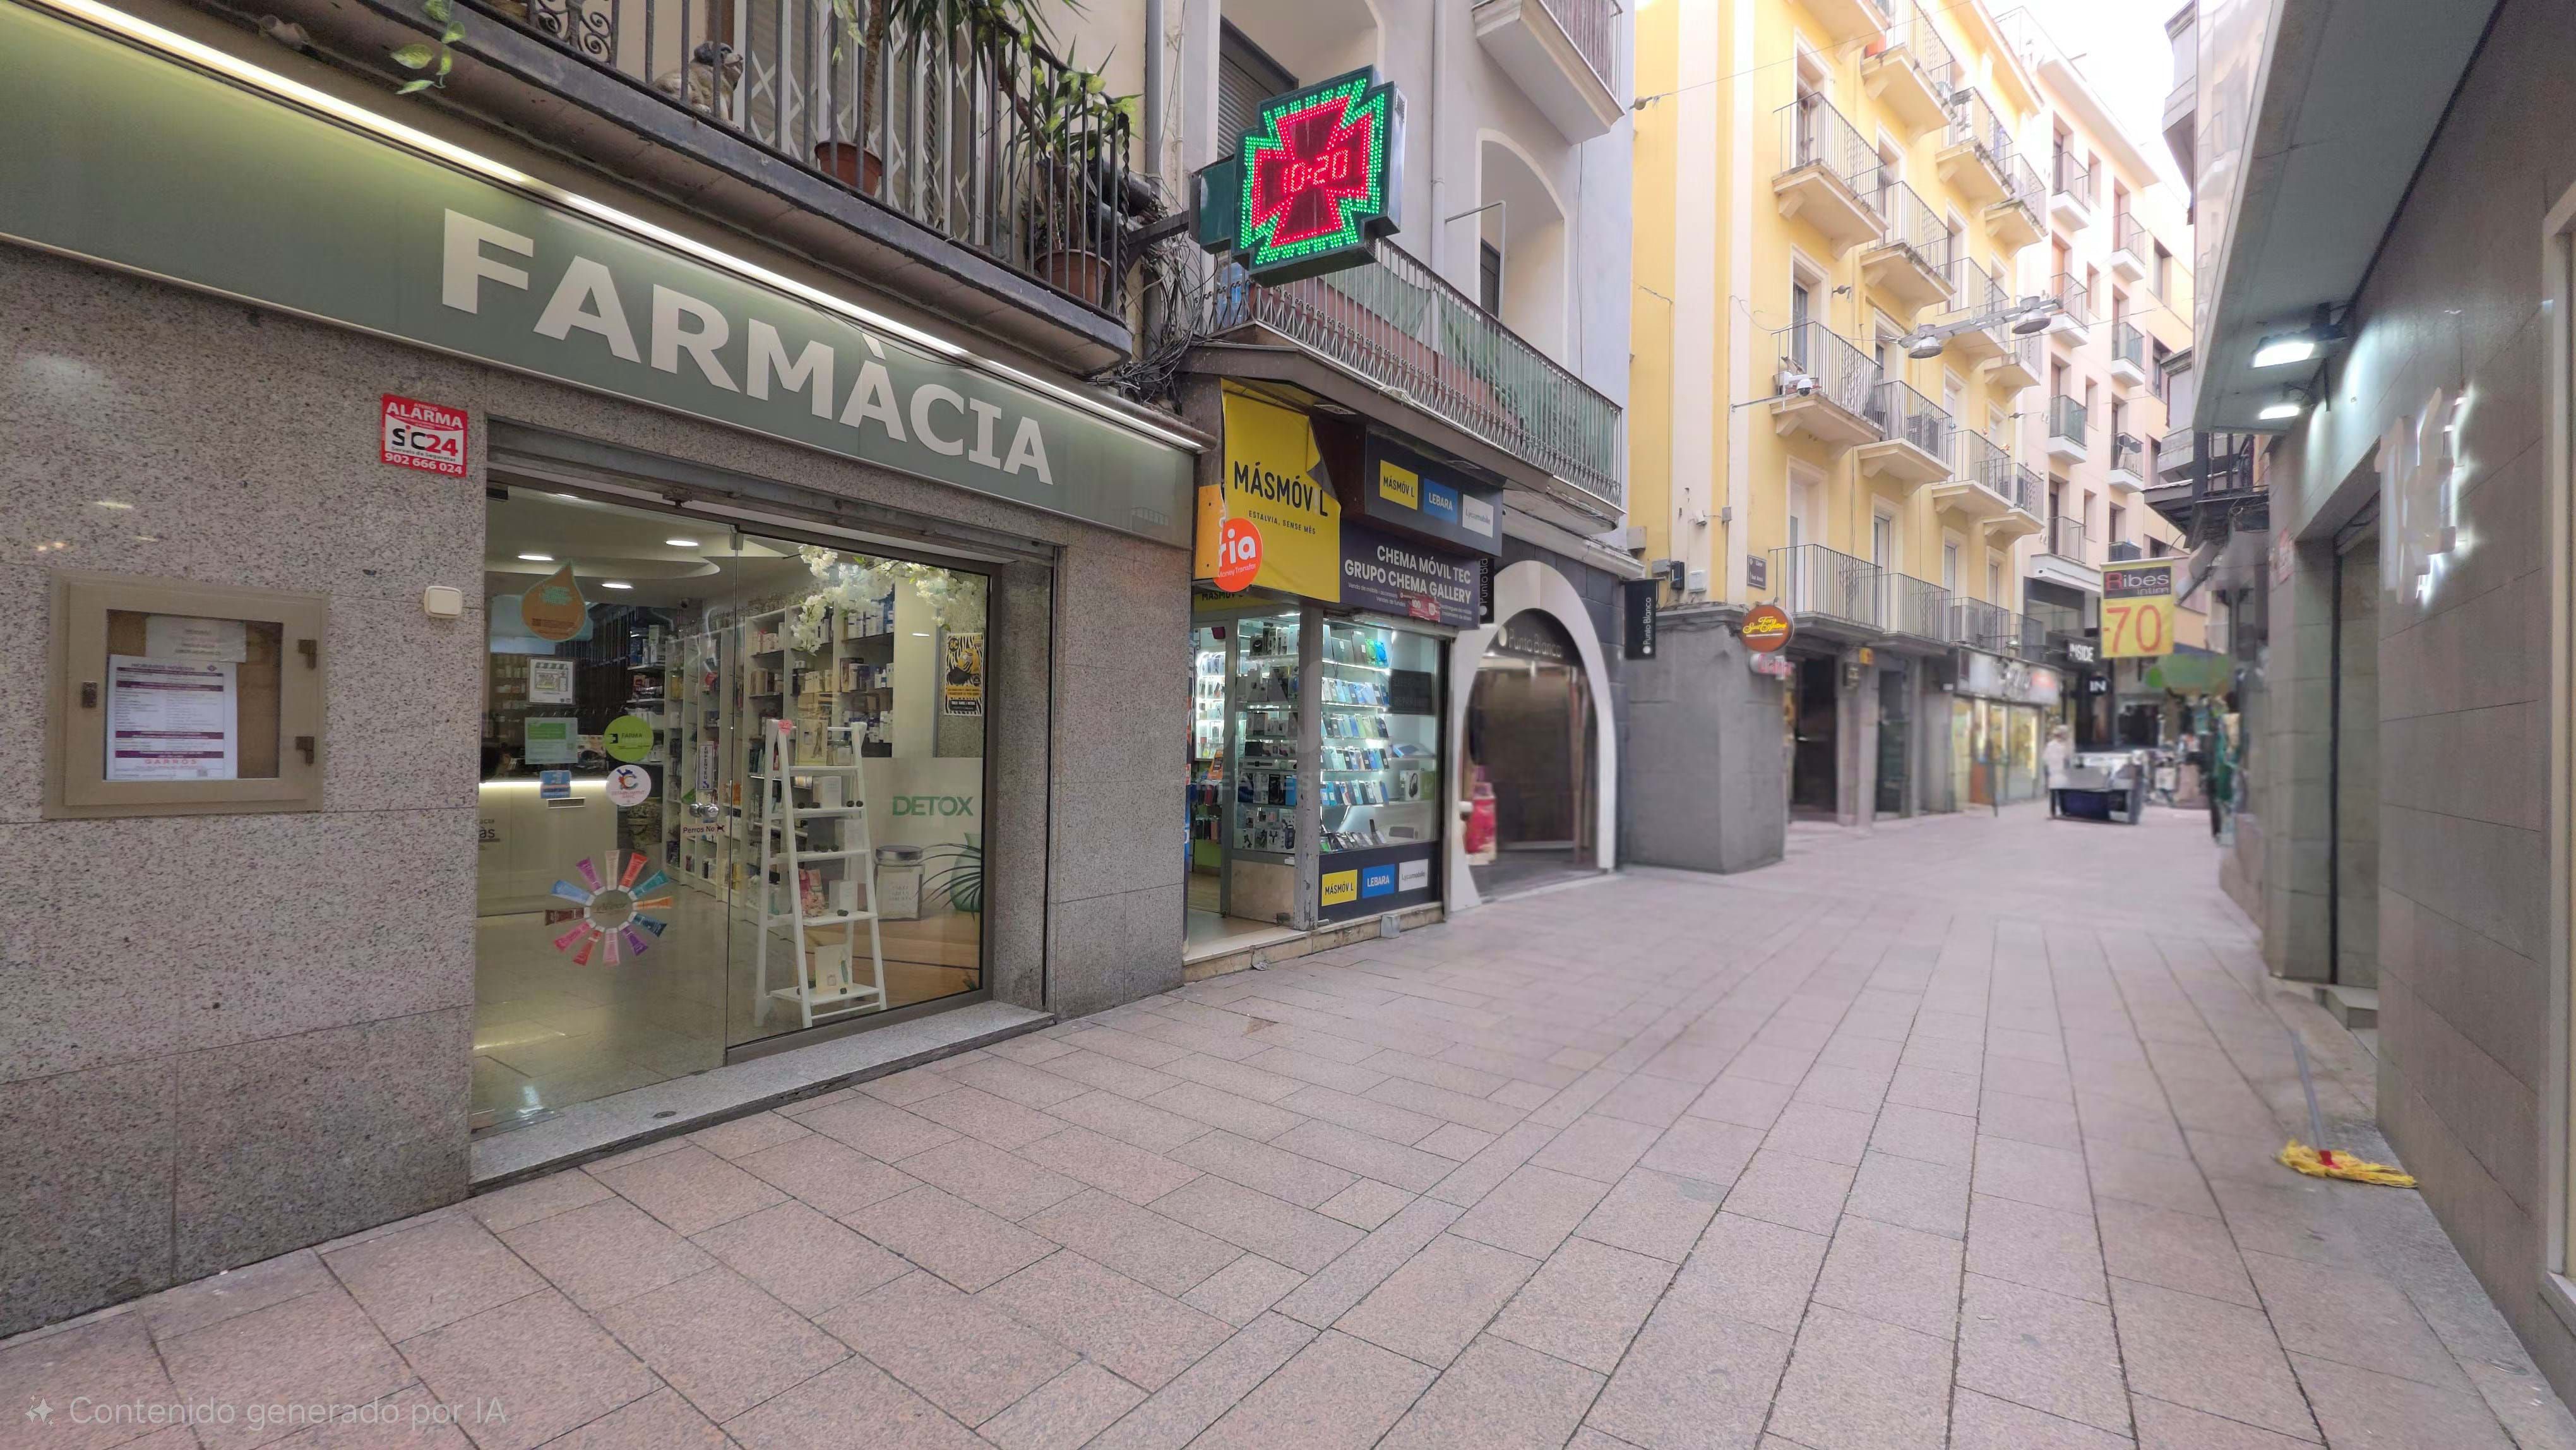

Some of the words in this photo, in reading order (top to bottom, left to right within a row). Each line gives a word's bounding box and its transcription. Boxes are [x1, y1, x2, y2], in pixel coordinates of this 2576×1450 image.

[1284, 149, 1349, 193] 10:20
[442, 208, 1053, 486] FARMÀCIA
[386, 402, 463, 429] ALARMA
[385, 452, 410, 465] 902
[412, 457, 436, 470] 666
[439, 463, 463, 474] 024
[1429, 492, 1453, 511] LEBARA
[1248, 510, 1280, 526] ESTALVIA,
[1282, 519, 1302, 531] SENSE
[1377, 545, 1417, 571] CHEMA
[1419, 556, 1452, 580] MÓVIL
[1453, 566, 1471, 584] TEC
[1344, 559, 1386, 584] GRUPO
[1388, 570, 1428, 594] CHEMA
[1429, 581, 1472, 604] GALLERY
[2106, 572, 2169, 591] Ribes
[1642, 597, 1652, 624] Blanco
[1509, 628, 1532, 652] Punto
[1534, 633, 1561, 657] Blanco
[1643, 625, 1651, 645] Punto
[892, 796, 974, 817] DETOX
[1367, 875, 1390, 887] LEBARA
